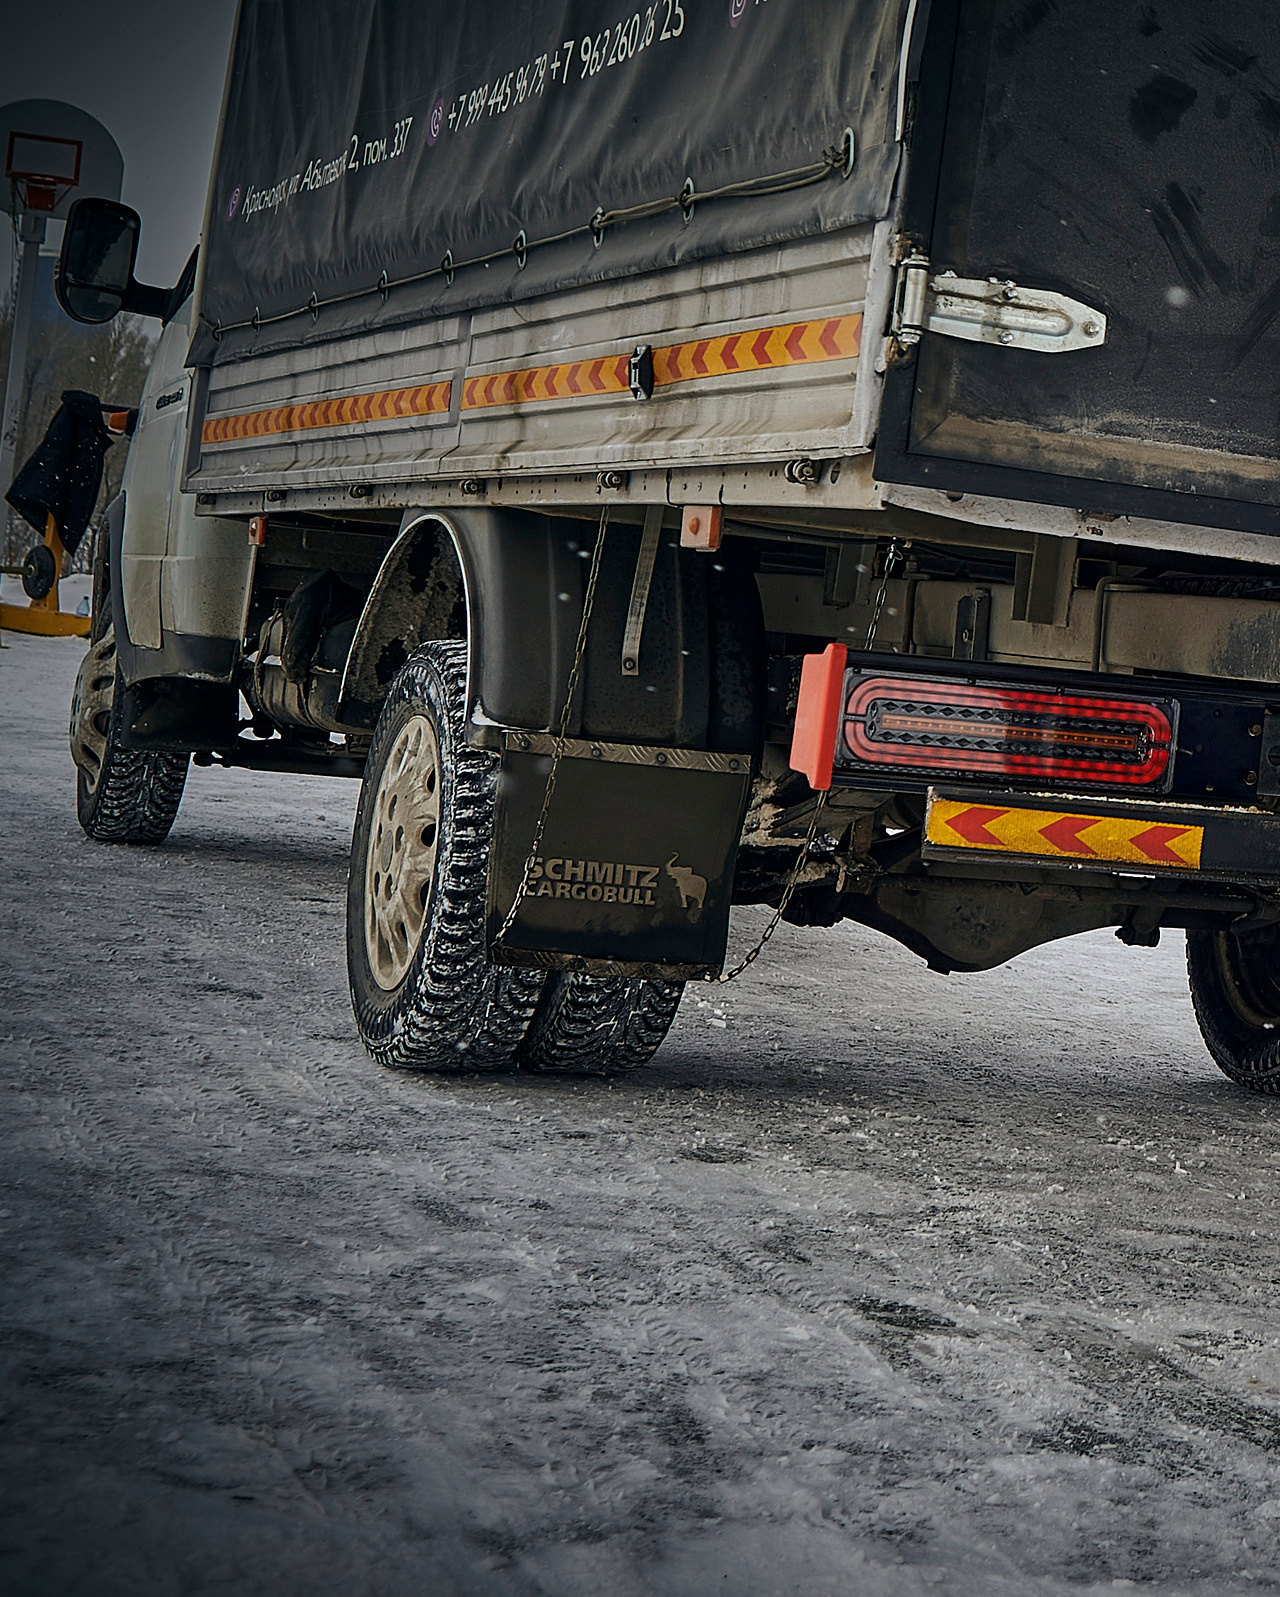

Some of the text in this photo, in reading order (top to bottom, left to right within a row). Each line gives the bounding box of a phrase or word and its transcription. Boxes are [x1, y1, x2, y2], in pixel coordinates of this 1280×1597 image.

[447, 94, 467, 132] +7
[464, 84, 489, 128] 999
[487, 72, 514, 117] 445
[513, 64, 531, 106] 96
[550, 40, 575, 84] +7
[580, 29, 611, 80] 963
[606, 13, 641, 67] 260
[638, 1, 659, 52] 26
[659, 0, 685, 41] 25
[347, 134, 359, 173] 2,
[363, 138, 388, 166] пом.
[390, 117, 414, 159] 337
[526, 857, 660, 888] SCHMITZ
